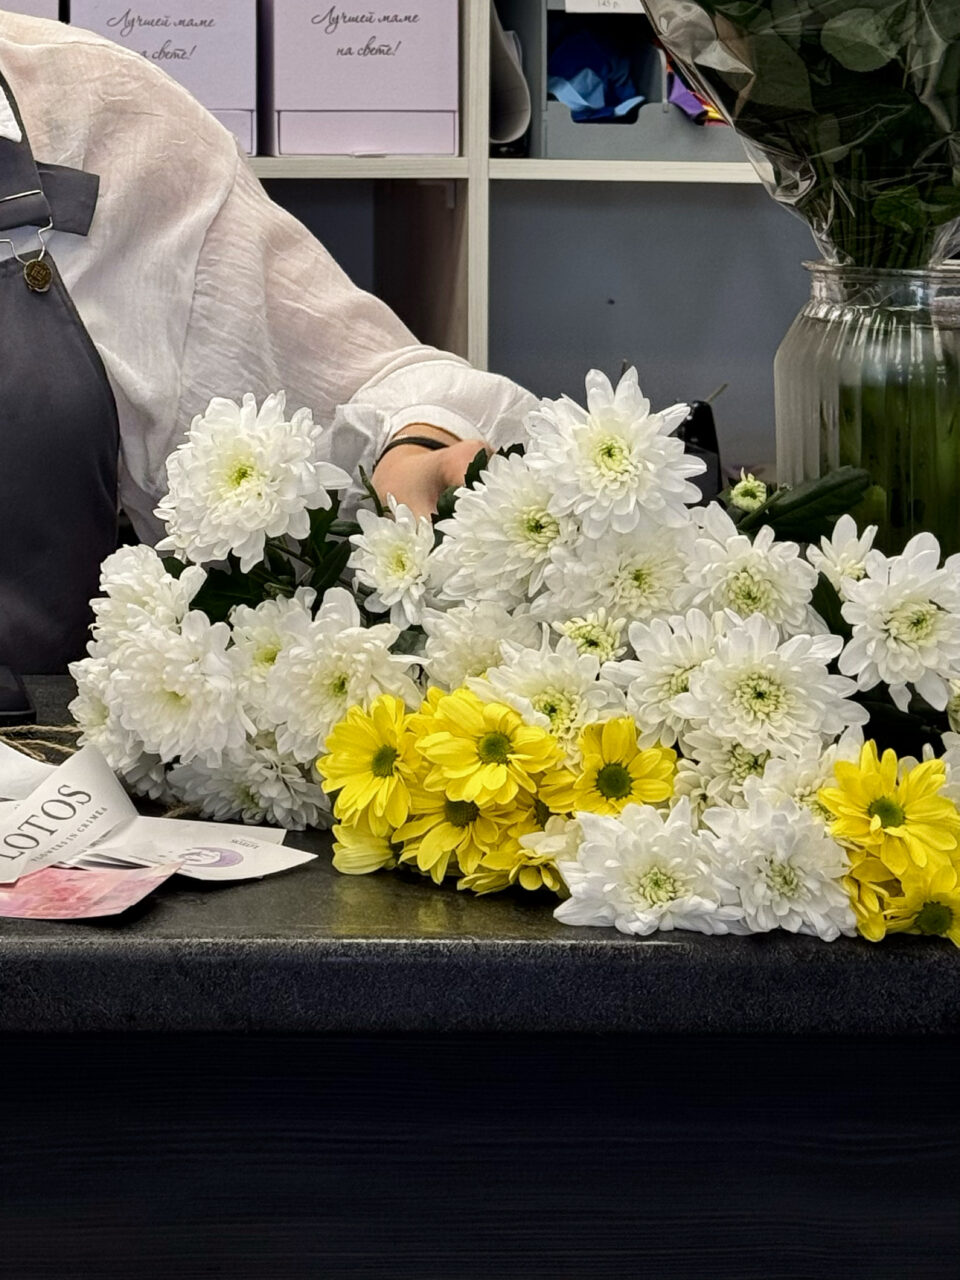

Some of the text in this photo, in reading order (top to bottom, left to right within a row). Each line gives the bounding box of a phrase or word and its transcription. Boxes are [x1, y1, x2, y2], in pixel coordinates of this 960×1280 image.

[106, 7, 217, 38] Лучшей маме
[310, 5, 421, 35] Лучшей маме
[151, 39, 198, 61] свете!
[336, 35, 402, 57] на свете!
